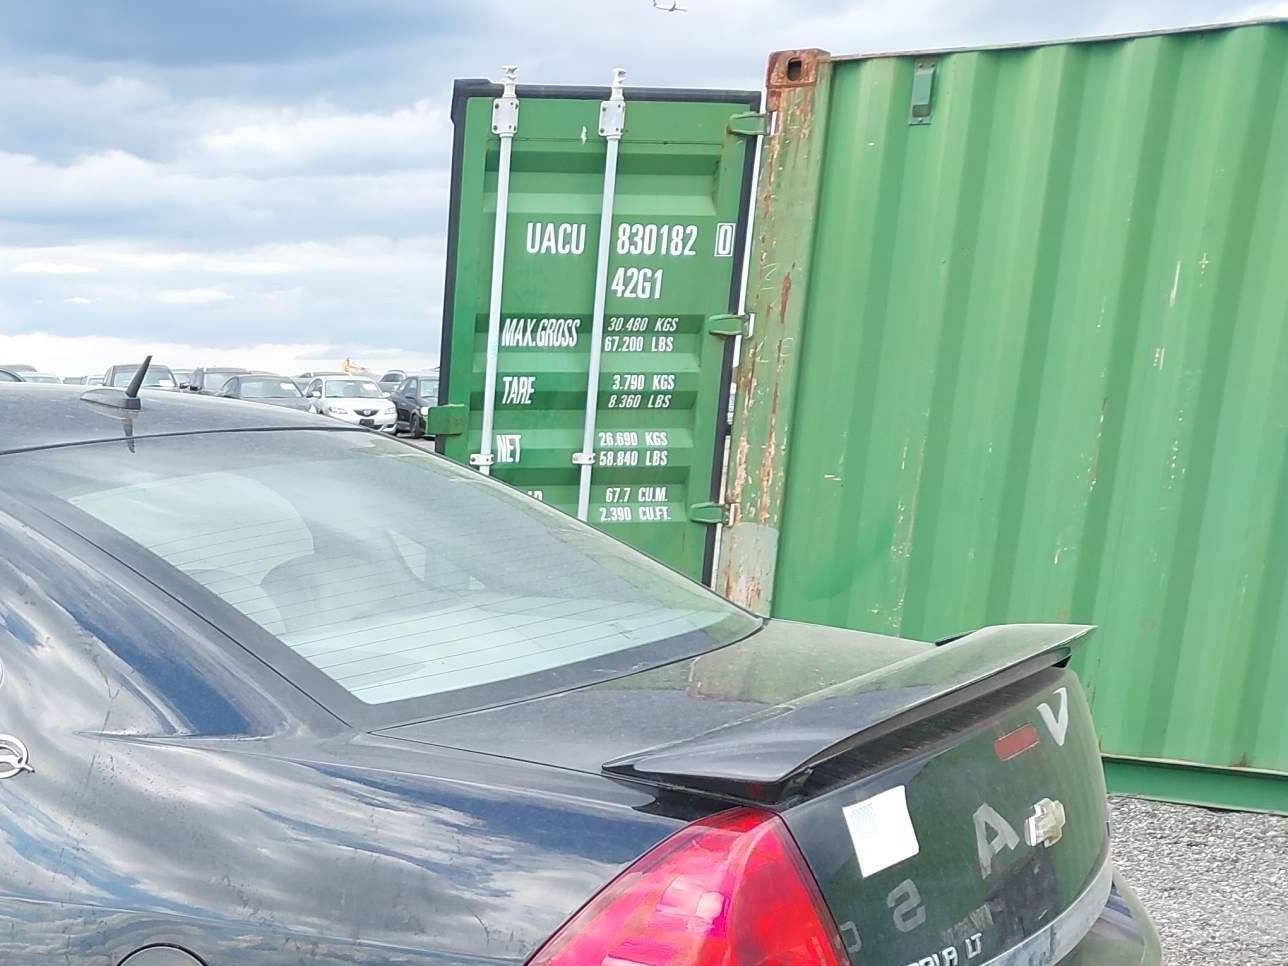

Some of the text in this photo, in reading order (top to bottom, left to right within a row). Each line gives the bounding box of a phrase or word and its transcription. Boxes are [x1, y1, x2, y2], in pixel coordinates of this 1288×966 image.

[526, 222, 586, 254] UACU
[616, 223, 698, 256] 830182
[611, 267, 663, 299] 42G1
[501, 318, 580, 347] MAX.GROSS
[607, 317, 679, 332] 30.480 KGS
[604, 336, 674, 352] 67.200 LBS
[612, 374, 675, 390] 3.790 KGS
[502, 376, 536, 405] TARE
[608, 394, 672, 408] 8.360 LBS
[598, 432, 668, 447] 26.690 KGS
[496, 435, 521, 463] NET
[599, 451, 668, 466] 58.840 LBS
[605, 487, 669, 503] 67.7 CU.M.
[600, 507, 632, 522] 2.390
[964, 932, 983, 960] LT
